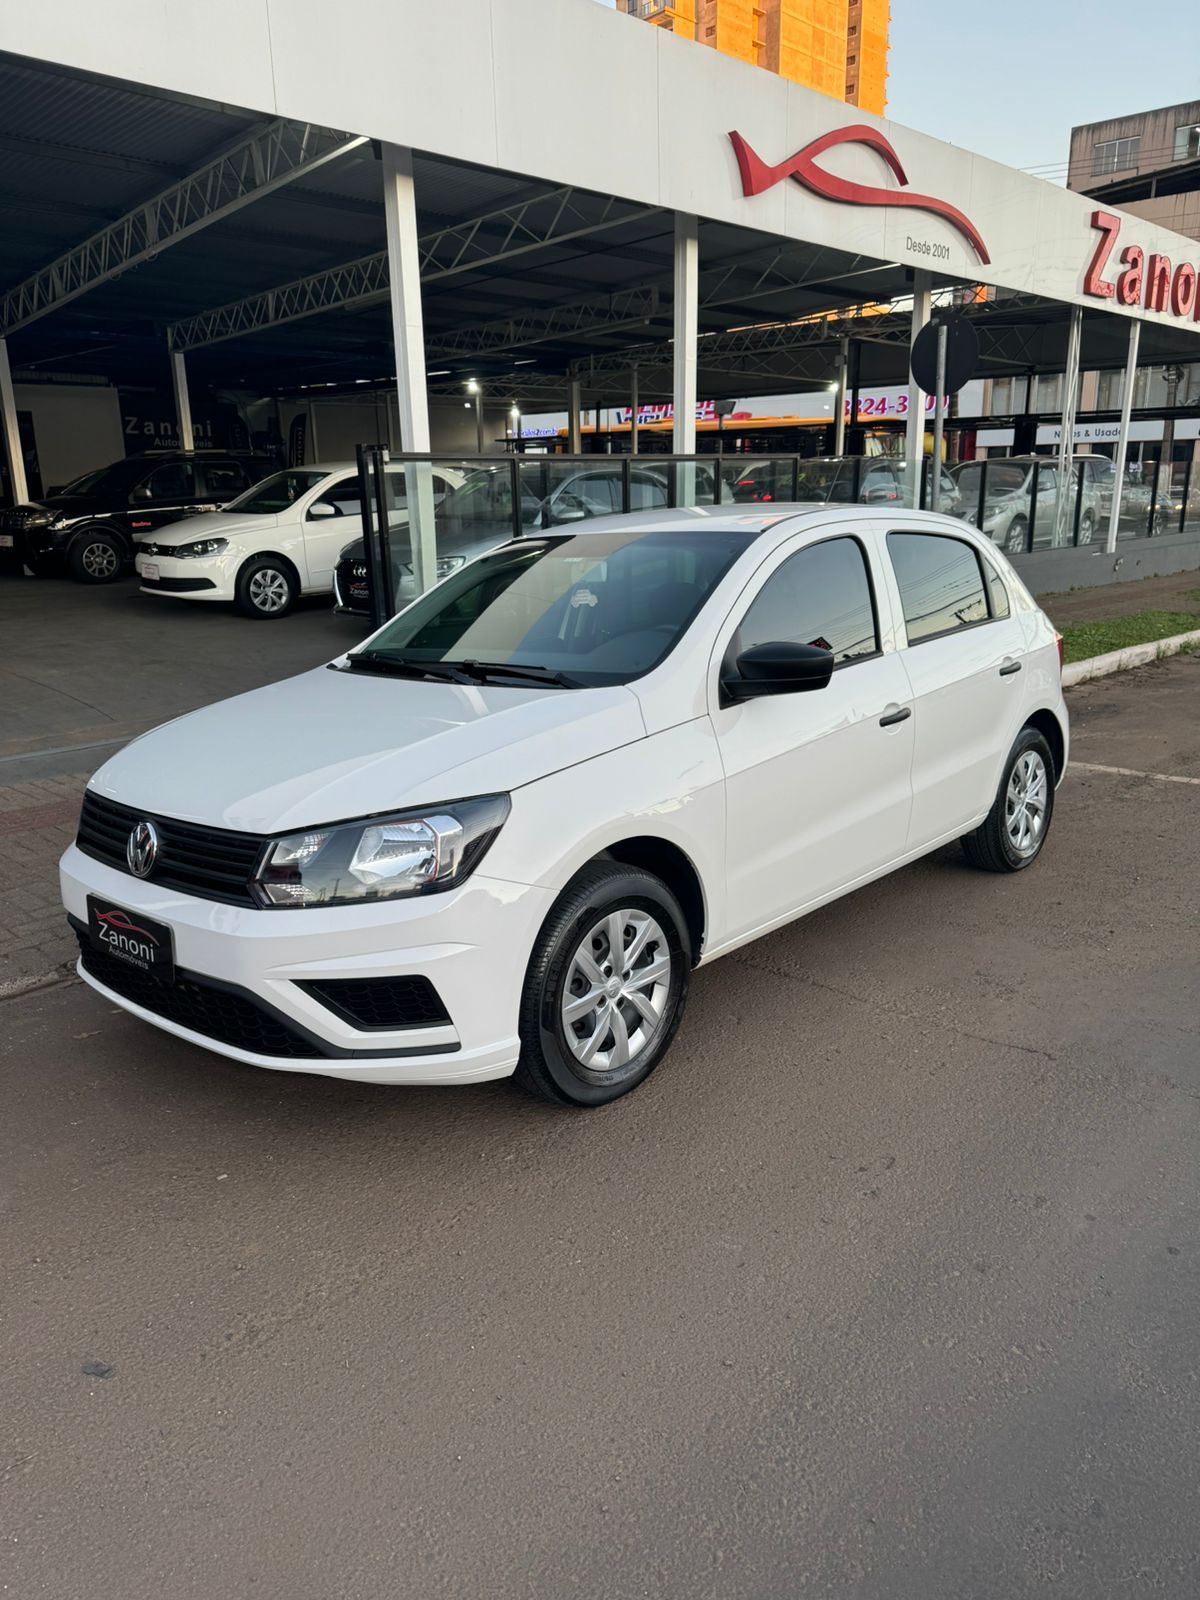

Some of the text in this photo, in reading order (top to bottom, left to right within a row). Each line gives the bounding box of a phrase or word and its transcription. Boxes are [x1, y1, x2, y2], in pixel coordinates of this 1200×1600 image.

[906, 236, 950, 260] Desde 2001
[1083, 210, 1200, 321] Zano
[154, 437, 213, 448] Autoveis
[98, 921, 154, 962] Zanoni
